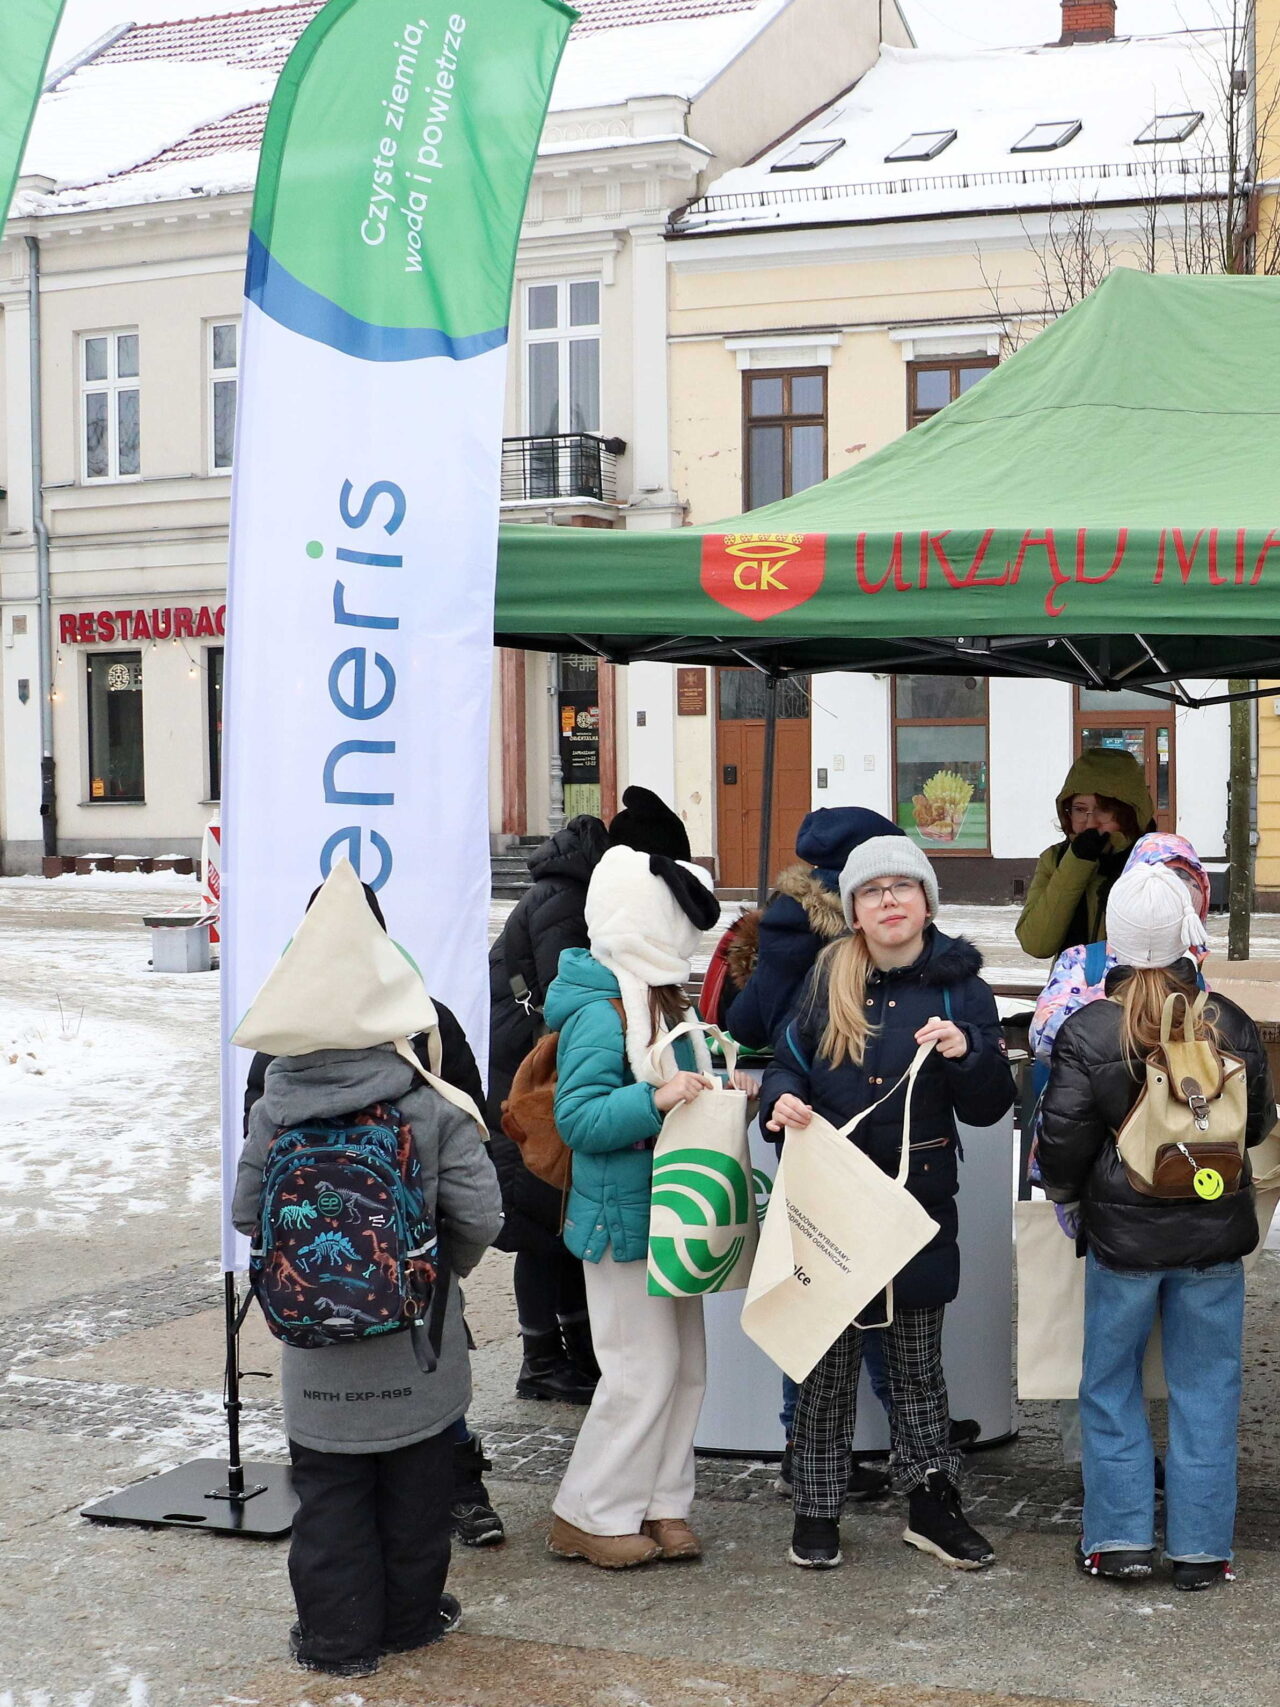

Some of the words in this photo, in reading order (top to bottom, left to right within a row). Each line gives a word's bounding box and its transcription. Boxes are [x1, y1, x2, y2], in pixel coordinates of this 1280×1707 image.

[417, 14, 466, 169] powietrze
[360, 137, 397, 246] Czyste
[381, 19, 429, 132] ziemia,
[405, 171, 432, 184] i
[400, 191, 428, 272] woda
[733, 560, 790, 590] CK
[59, 604, 226, 644] RESTAURAC
[306, 477, 407, 894] eneris
[785, 1198, 818, 1234] LORAZÓWKI
[817, 1231, 851, 1262] WYBIERAMY
[812, 1237, 852, 1275] OGRANICZAMY
